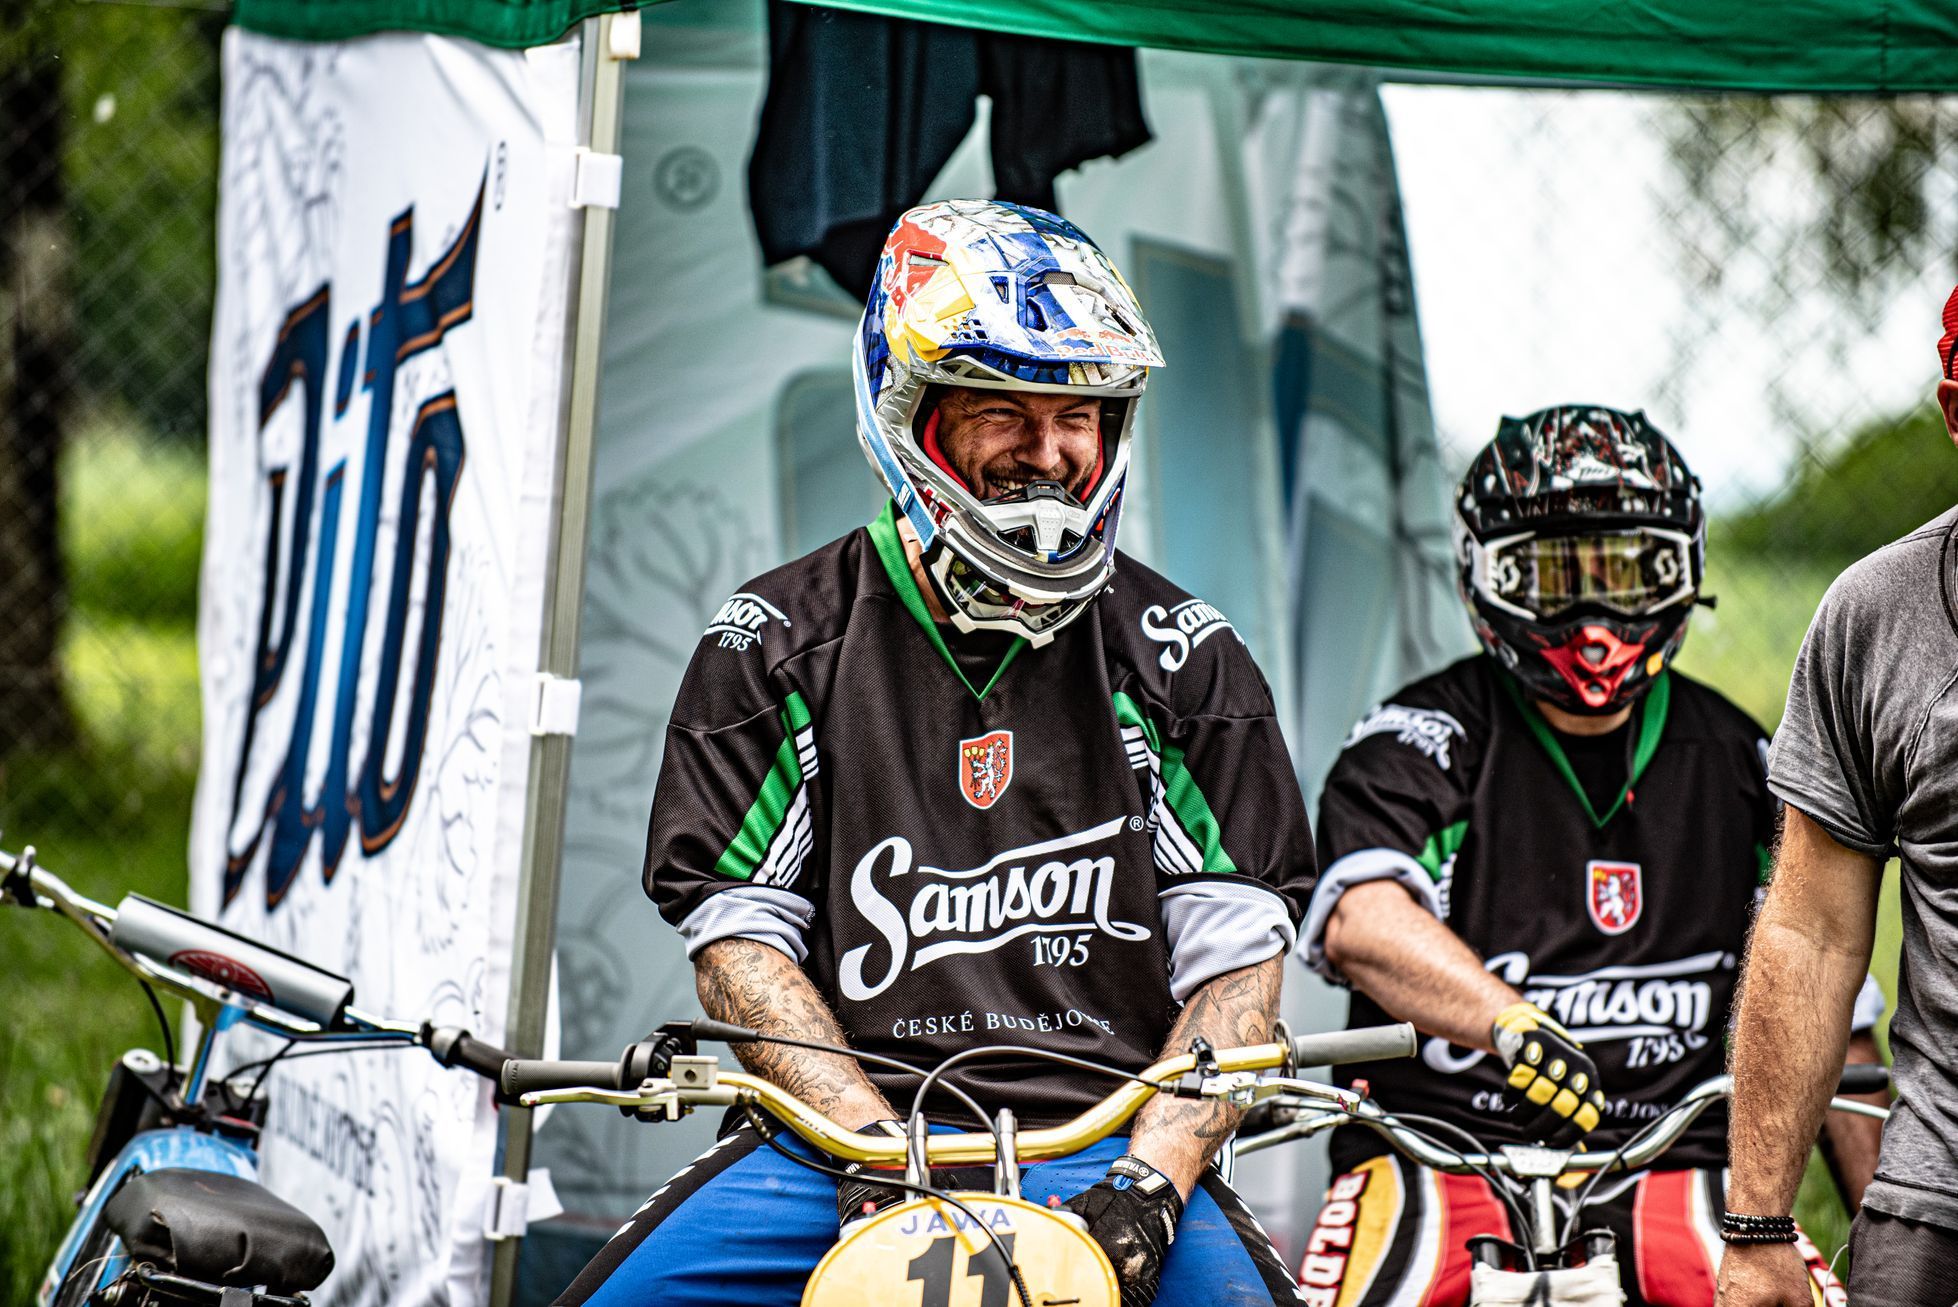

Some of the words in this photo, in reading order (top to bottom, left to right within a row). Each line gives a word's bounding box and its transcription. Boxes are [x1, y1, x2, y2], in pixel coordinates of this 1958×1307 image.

[718, 632, 752, 651] 1795
[840, 835, 1151, 1001] Samson
[1031, 934, 1093, 967] 1795
[893, 1010, 975, 1038] ČESKÉ
[901, 1208, 1011, 1235] JAWA
[907, 1232, 1016, 1307] 11
